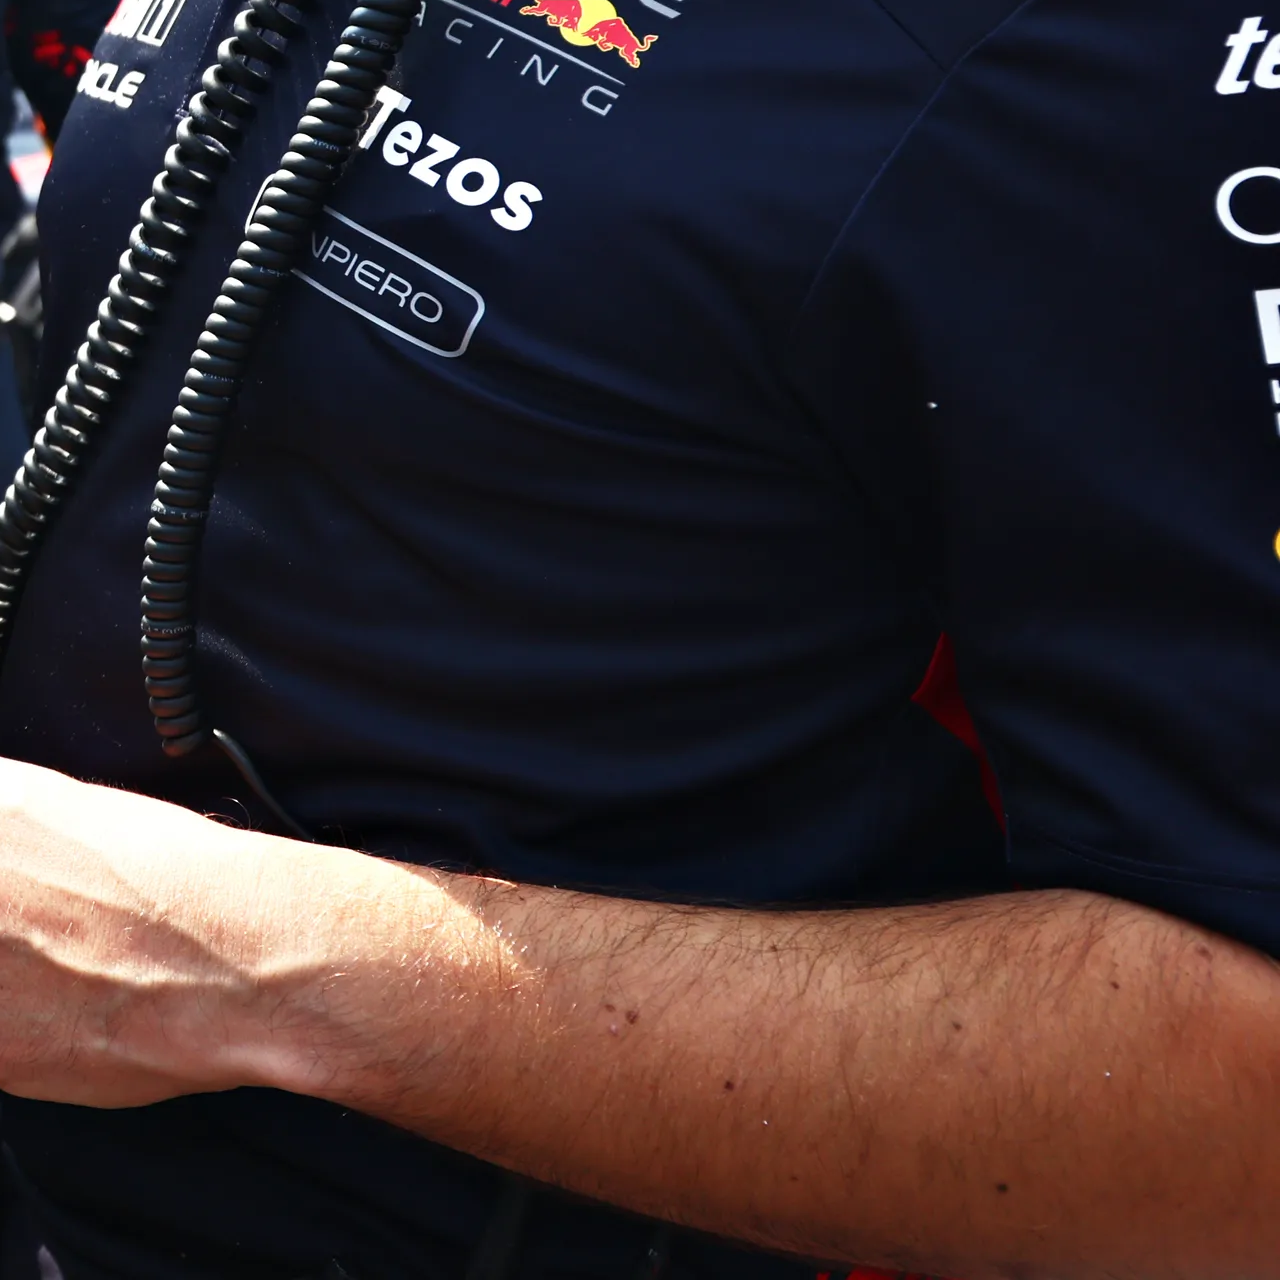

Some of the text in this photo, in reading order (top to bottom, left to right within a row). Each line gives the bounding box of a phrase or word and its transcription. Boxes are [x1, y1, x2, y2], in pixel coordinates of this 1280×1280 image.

[414, 0, 620, 117] ACING
[1213, 15, 1280, 96] te
[358, 84, 544, 232] Tezos
[310, 230, 444, 324] NPIERO
